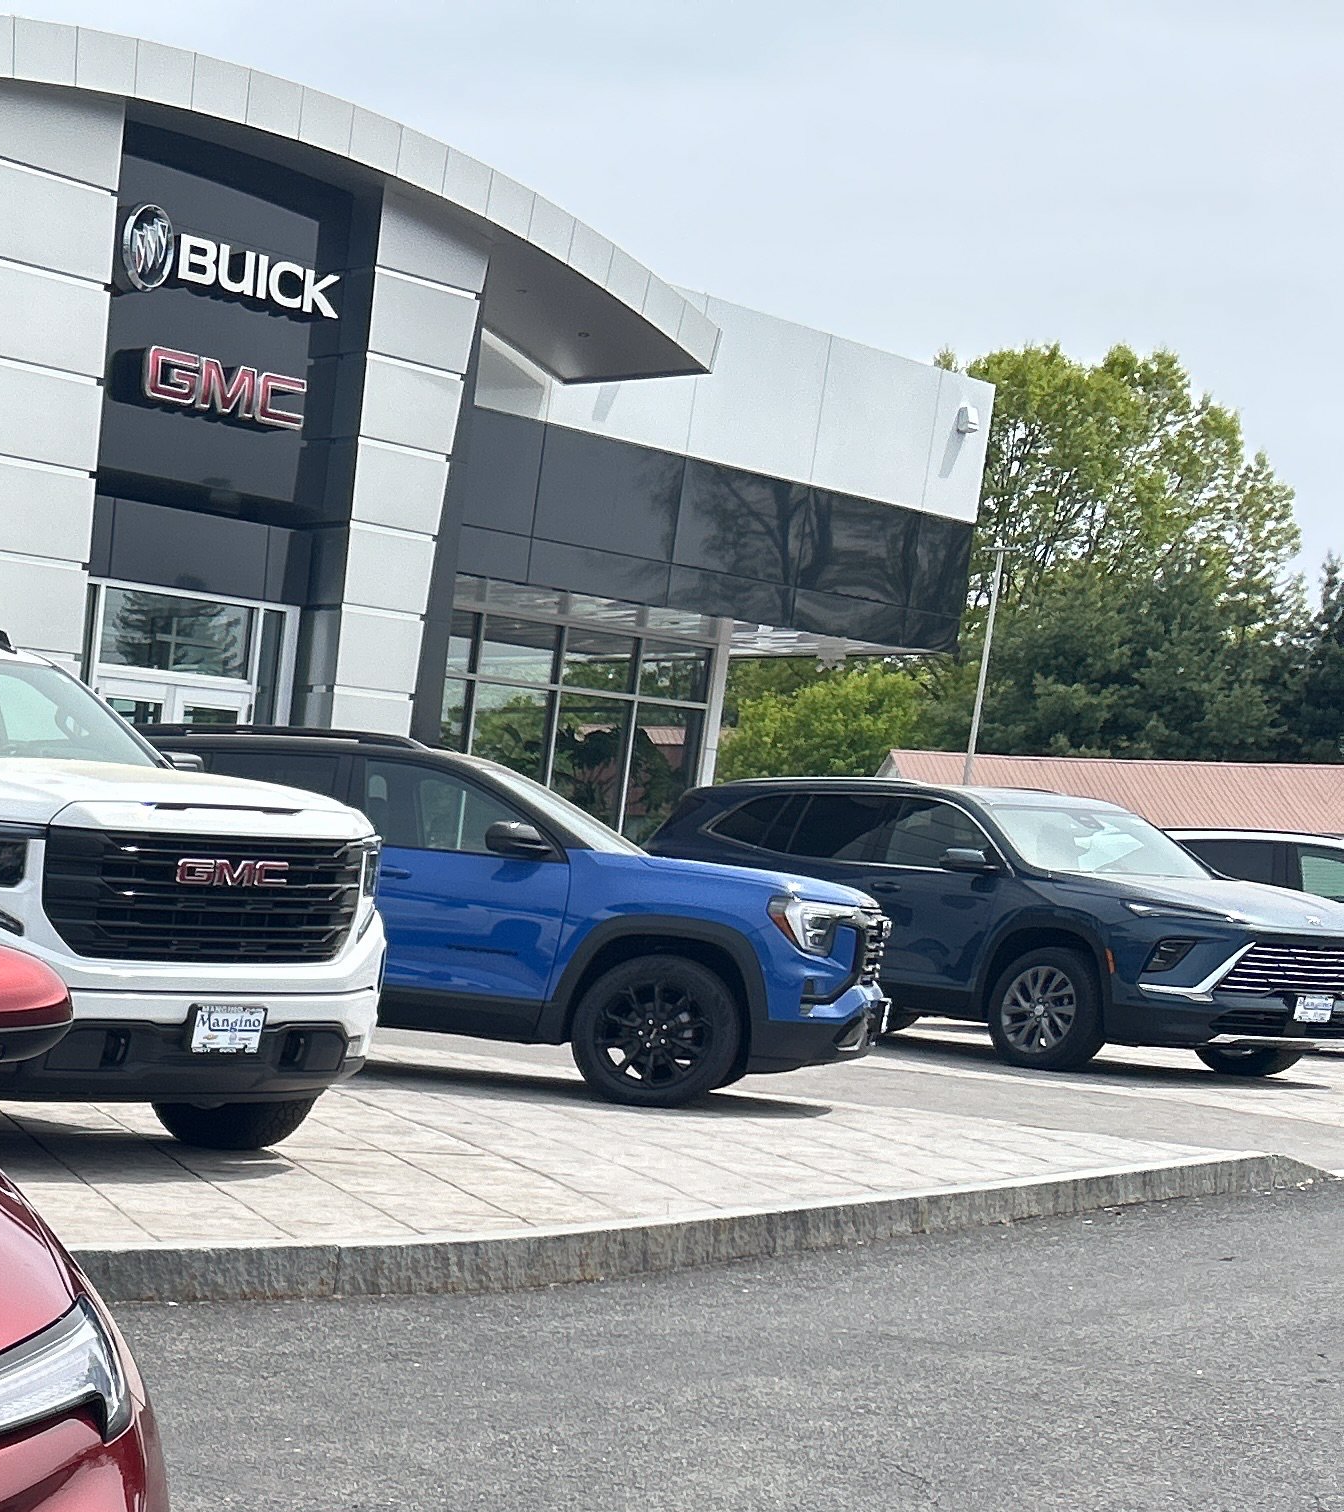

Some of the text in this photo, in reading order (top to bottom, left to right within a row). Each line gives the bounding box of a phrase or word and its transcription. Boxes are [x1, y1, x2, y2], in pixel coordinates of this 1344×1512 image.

[177, 233, 341, 319] BUICK
[144, 345, 308, 431] GMC
[175, 858, 289, 887] GMC
[196, 1013, 261, 1033] Mangino
